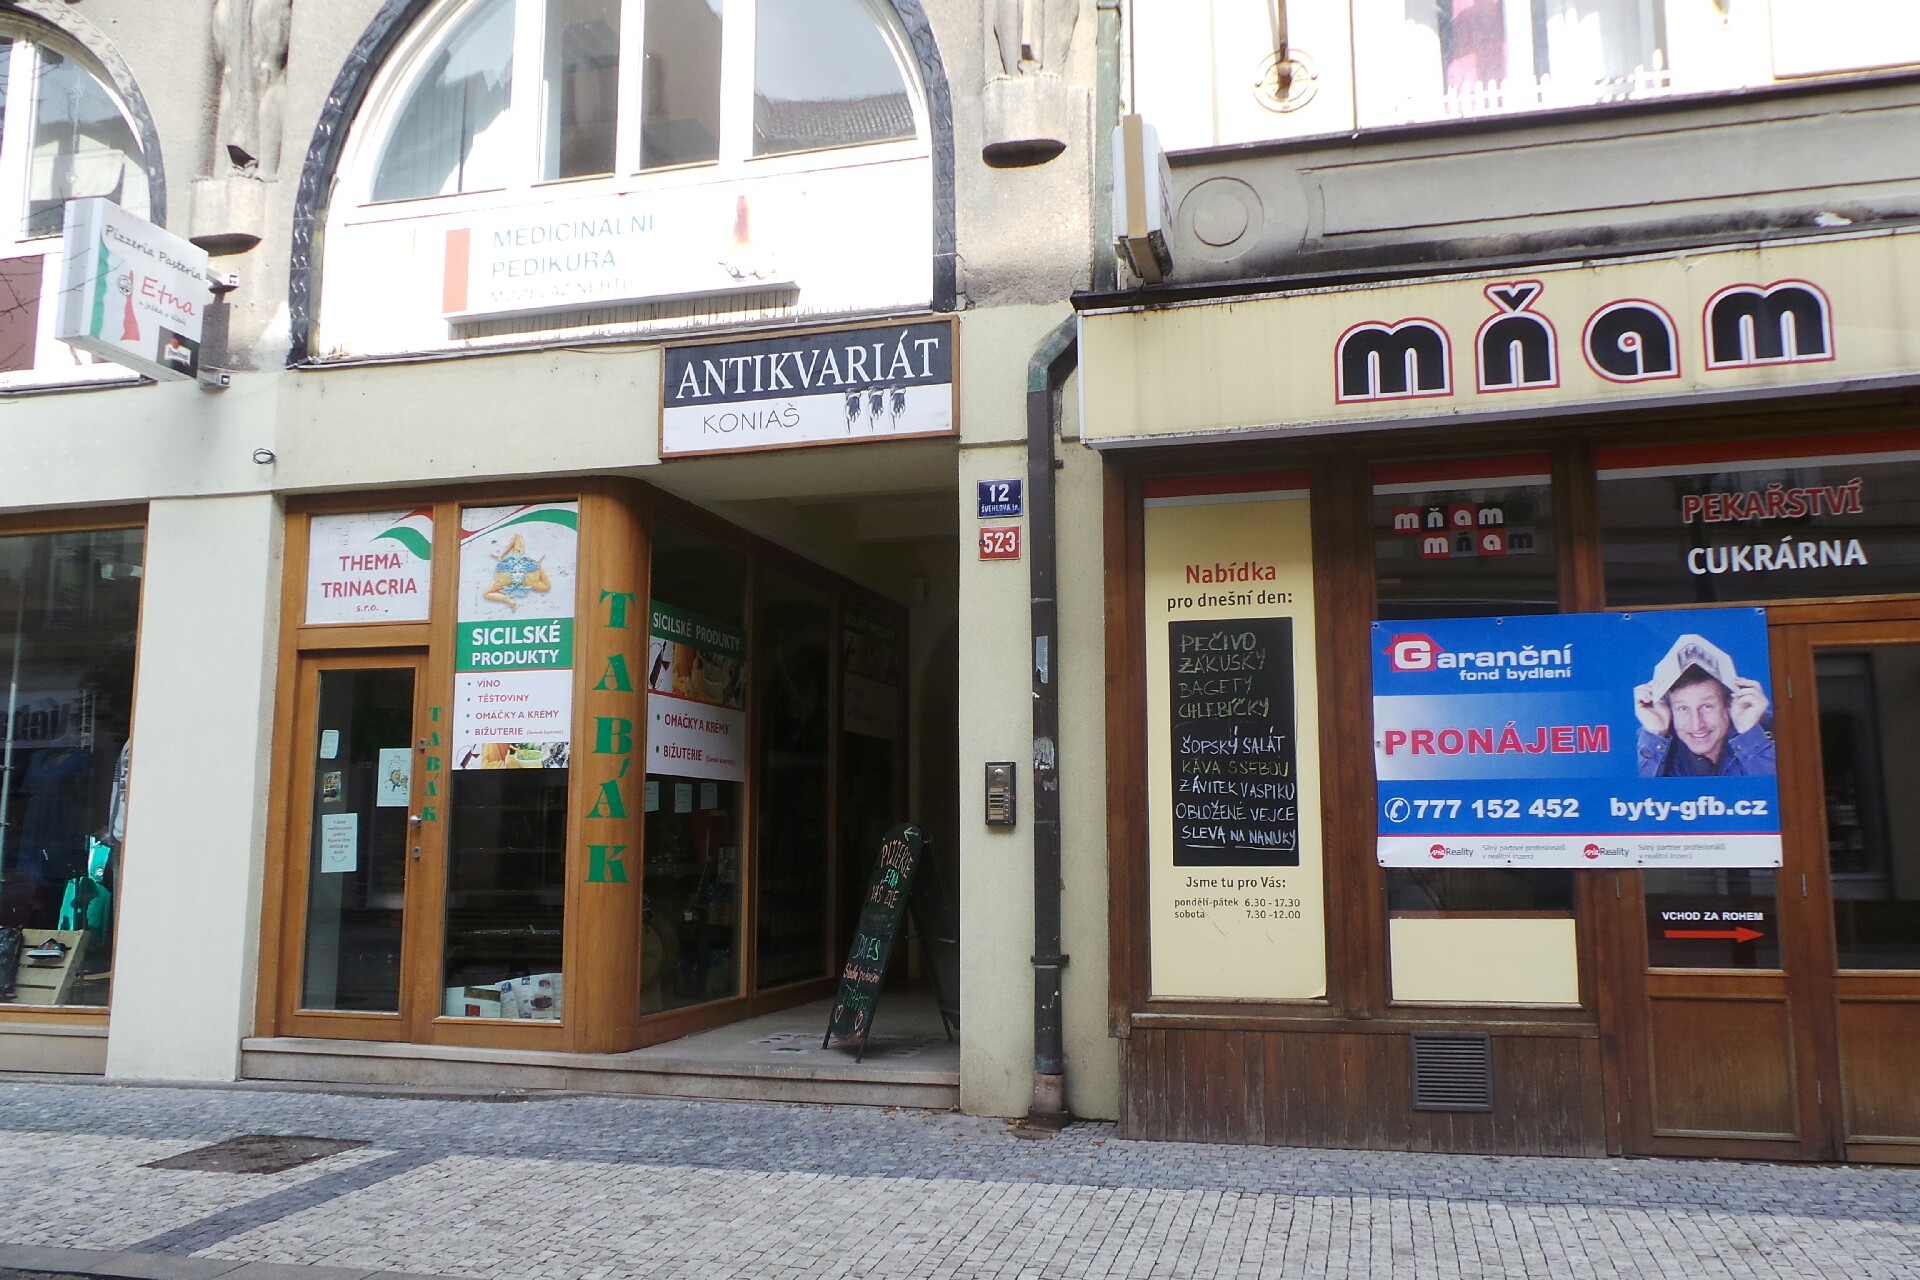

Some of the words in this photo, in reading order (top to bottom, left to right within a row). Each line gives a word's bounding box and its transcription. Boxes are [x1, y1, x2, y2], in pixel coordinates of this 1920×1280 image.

[105, 224, 155, 258] Pizzeria
[159, 251, 203, 281] Pasteria
[141, 275, 196, 316] Etna
[1334, 277, 1836, 405] mňam
[675, 329, 939, 399] ANTIKVARIÁT
[989, 484, 1009, 502] 12
[1682, 477, 1864, 523] PEKAŘSTVÍ
[981, 504, 1011, 513] ŠVEHLOVA
[1394, 507, 1504, 530] mňam
[983, 531, 1016, 554] 523
[339, 553, 402, 572] THEMA
[1687, 534, 1868, 575] CUKRÁRNA
[1186, 561, 1277, 584] Nabídka
[321, 577, 418, 599] TRINACRIA
[356, 604, 379, 613] s.r.o.
[1167, 595, 1193, 612] pro
[1197, 590, 1253, 607] dnešní
[1257, 589, 1293, 605] den:
[471, 620, 561, 646] SICILSKÉ
[653, 611, 692, 638] SICILSKÉ
[695, 625, 741, 651] PRODUKTY
[1179, 631, 1257, 653] PEČIVO
[471, 649, 560, 666] PRODUKTY
[1178, 648, 1266, 674] ZÁKUSKY
[1394, 640, 1574, 669] Garanční
[476, 678, 501, 688] VÍNO
[1459, 668, 1500, 681] fond
[1506, 666, 1572, 681] bydlení
[1178, 675, 1252, 698] BAGETY
[477, 693, 530, 703] TĚSTOVINY
[1178, 697, 1270, 719] CHLEBÍČKY
[475, 709, 516, 720] OMÁČKY
[518, 711, 525, 719] A
[527, 708, 560, 719] KRÉMY
[664, 712, 698, 731] OMÁČKY
[698, 719, 704, 731] A
[474, 726, 523, 736] BIŽUTERIE
[584, 588, 637, 884] TABÁK
[1180, 725, 1238, 755] ŠOPSKÝ
[1243, 725, 1286, 755] SALÁT
[1384, 720, 1610, 756] PRONÁJEM
[663, 742, 703, 762] BIŽUTERIE
[1182, 758, 1221, 775] KÁVA
[1178, 775, 1239, 796] ZÁVITEK
[1175, 800, 1247, 820] OBLOŽENÉ
[1250, 806, 1295, 822] VEJCE
[1413, 798, 1468, 819] 777
[1471, 798, 1520, 819] 152
[1529, 798, 1580, 818] 452
[1610, 796, 1769, 821] byty-gfb.cz
[1181, 825, 1226, 844] SLEVA
[1230, 829, 1245, 842] NA
[1185, 876, 1218, 888] Jsme
[1220, 877, 1234, 888] tu
[1237, 878, 1258, 890] pro
[1260, 875, 1287, 888] Vás:
[1174, 897, 1239, 909] pondělí-pátek
[1244, 898, 1266, 908] 6.30
[1174, 910, 1205, 919] sobota
[1246, 910, 1266, 919] 7.30
[1662, 911, 1701, 922] VCHOD
[1704, 911, 1719, 921] ZA
[1722, 910, 1764, 921] ROHEM
